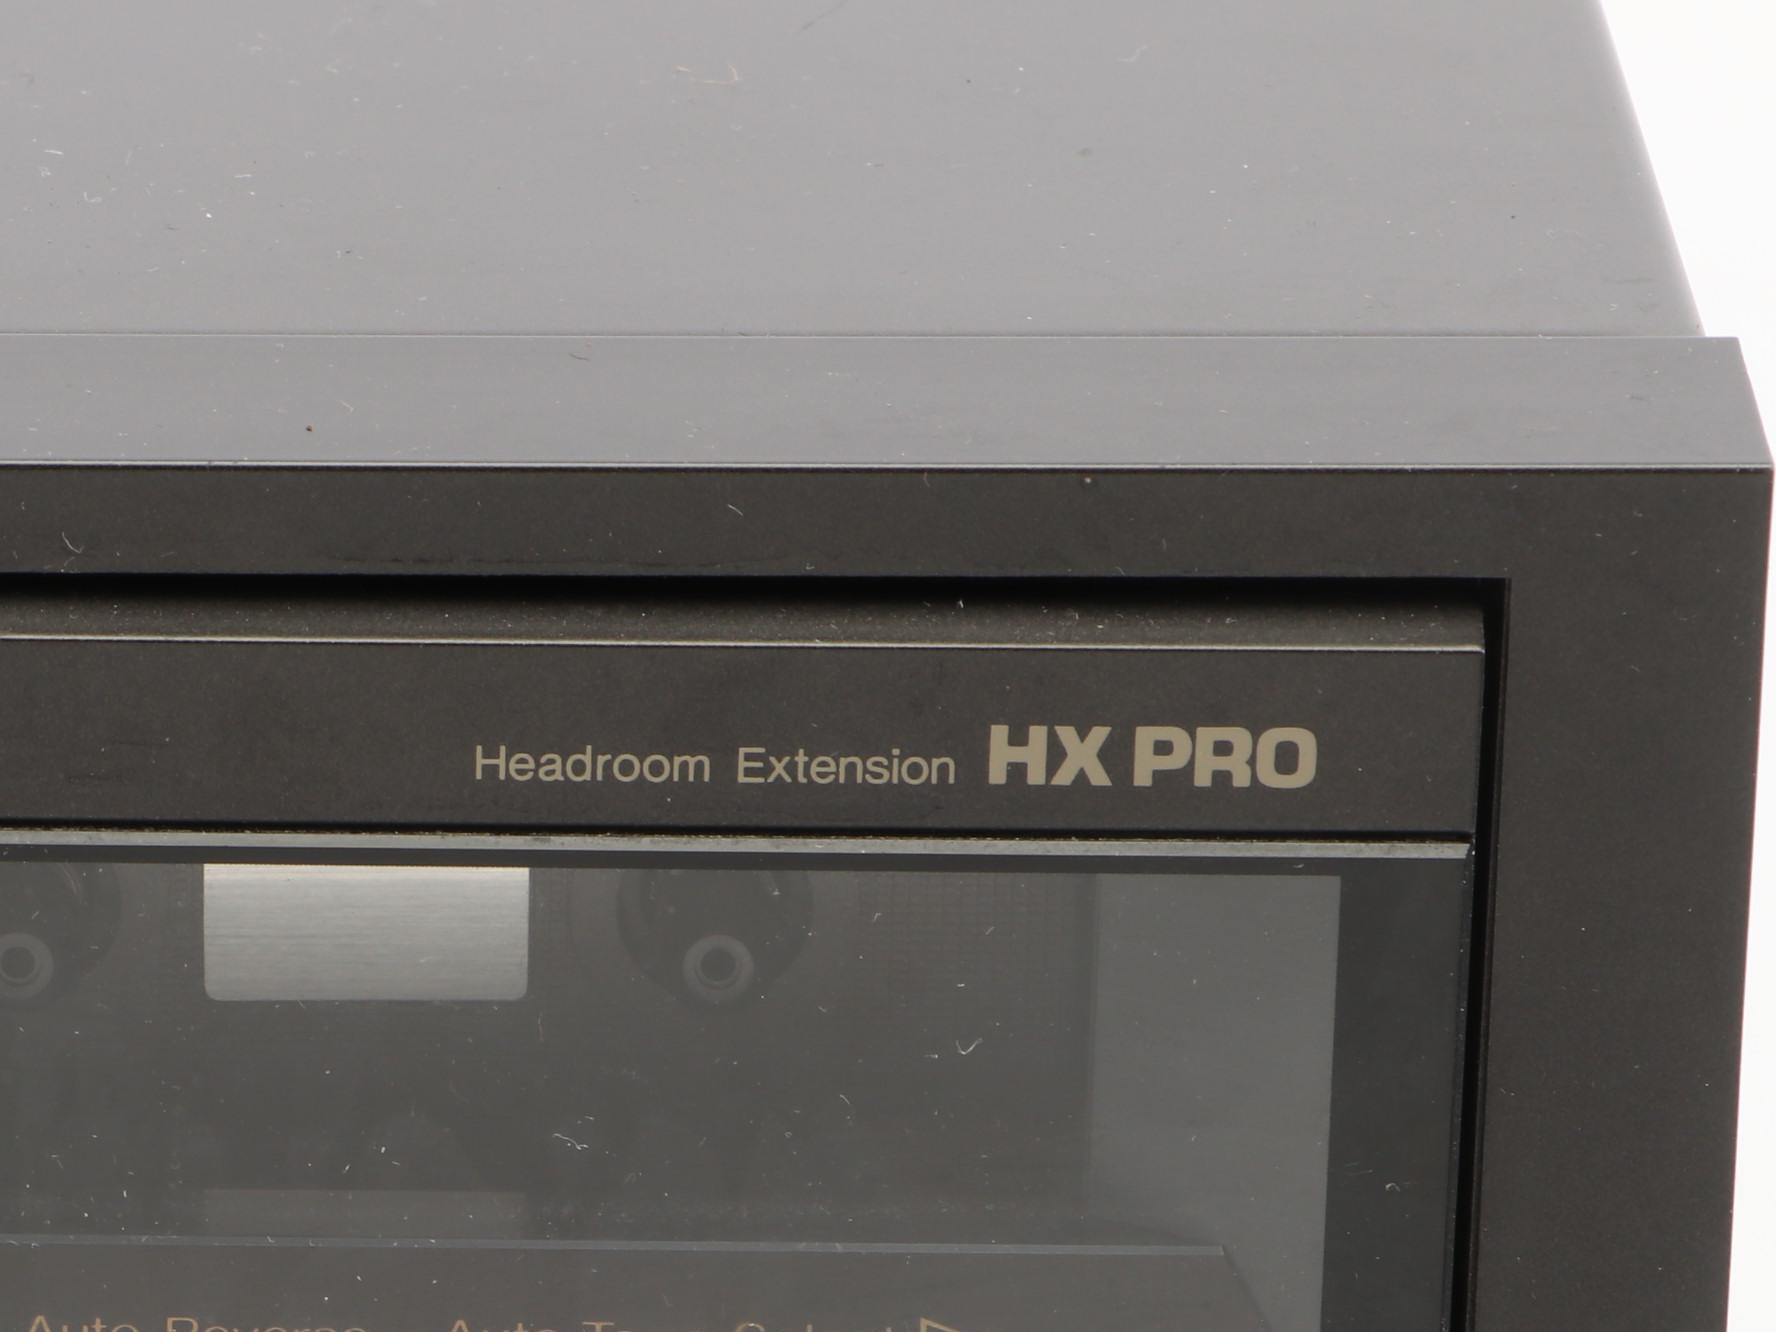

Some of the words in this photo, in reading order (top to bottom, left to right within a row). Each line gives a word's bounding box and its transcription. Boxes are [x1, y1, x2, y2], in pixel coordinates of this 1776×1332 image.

[475, 744, 711, 783] Headroom
[737, 747, 956, 785] Extension
[988, 724, 1113, 786] HX
[1133, 725, 1318, 789] PRO
